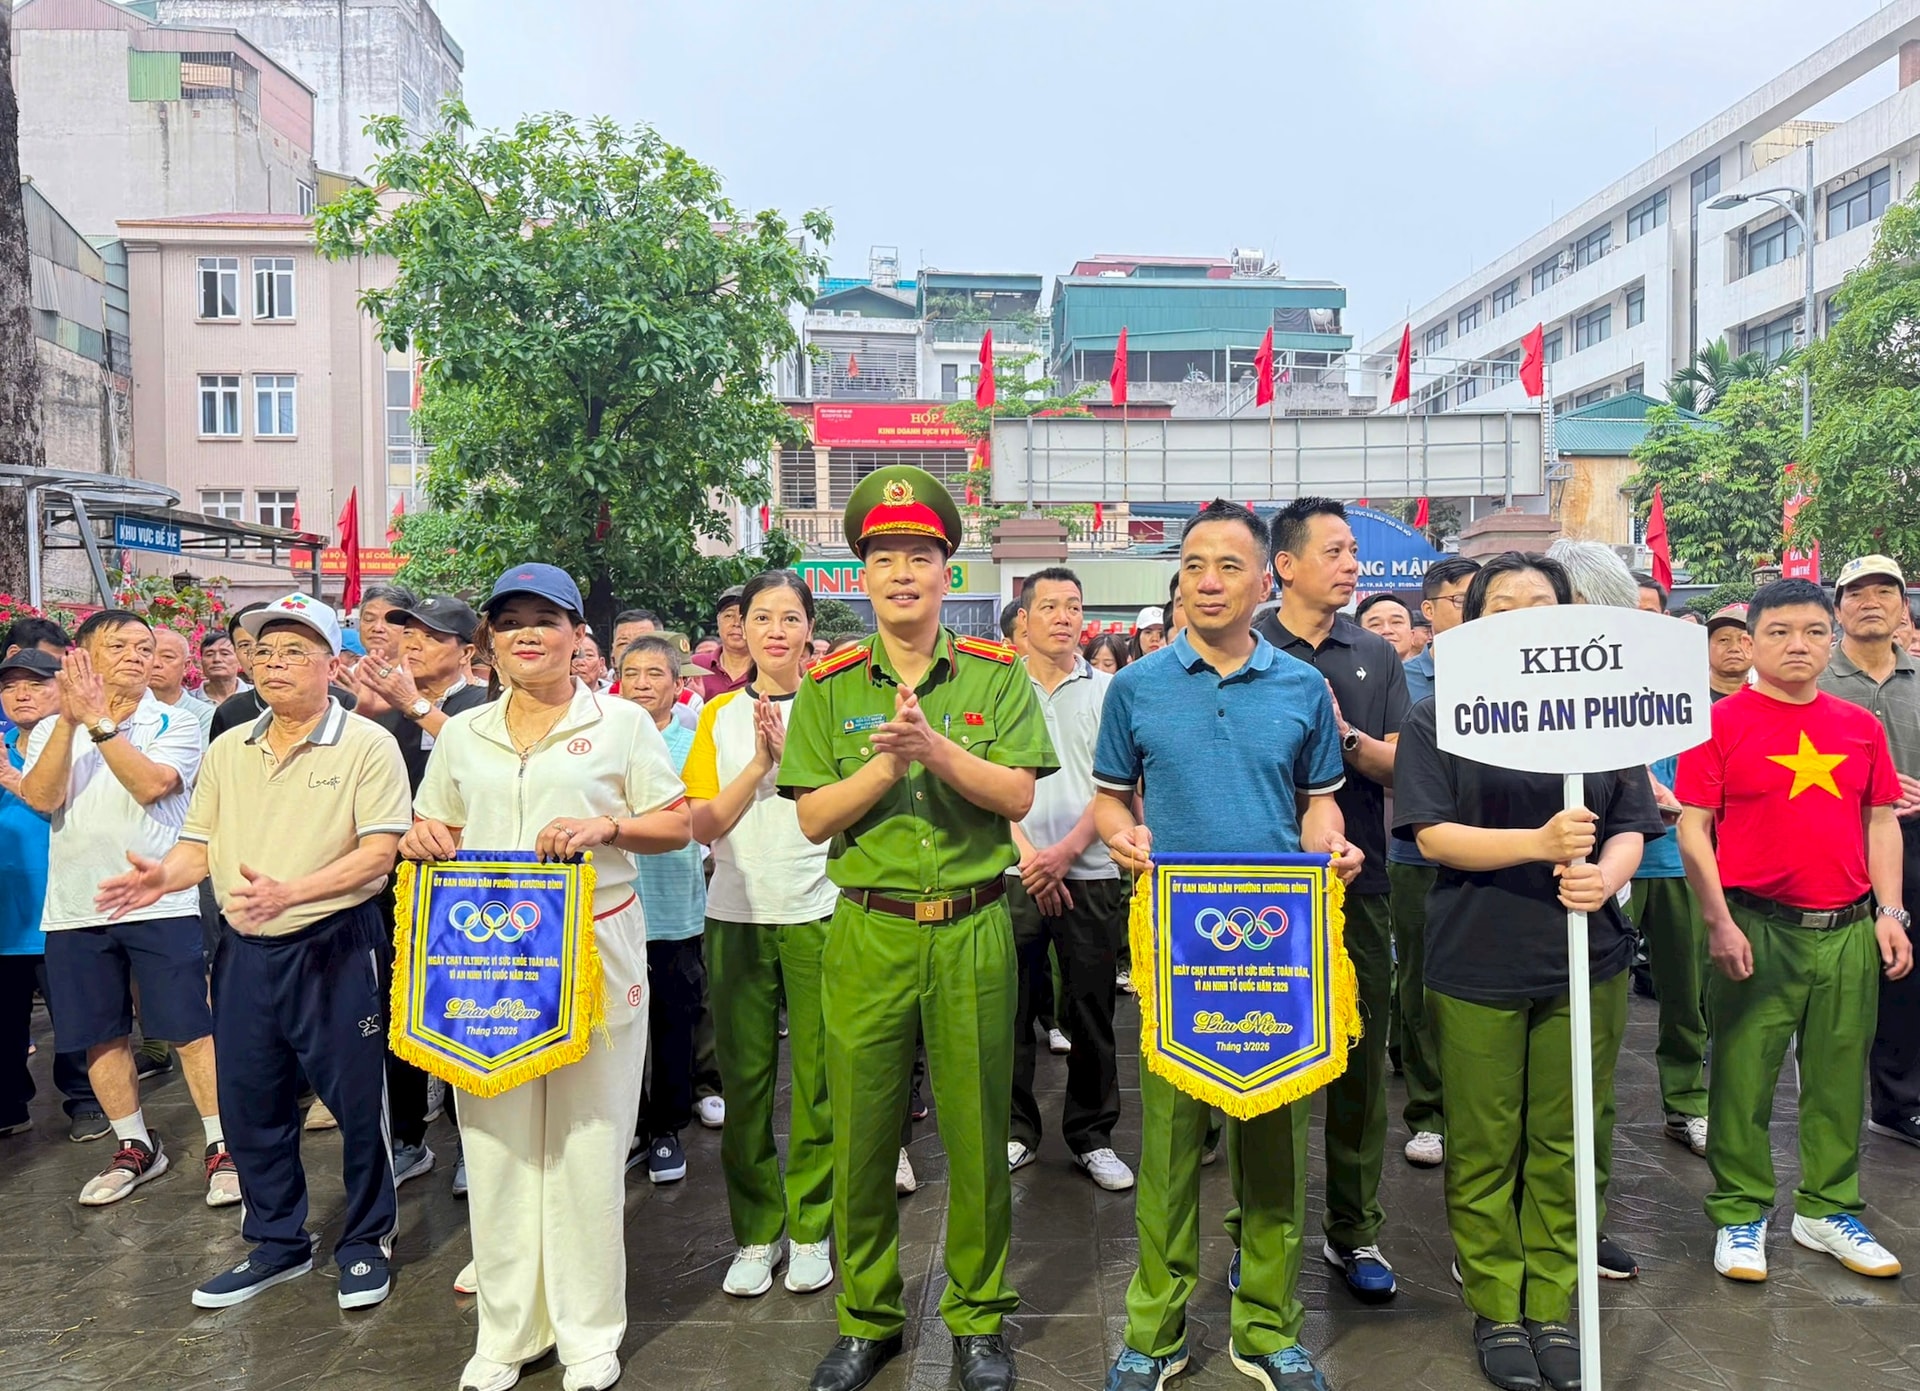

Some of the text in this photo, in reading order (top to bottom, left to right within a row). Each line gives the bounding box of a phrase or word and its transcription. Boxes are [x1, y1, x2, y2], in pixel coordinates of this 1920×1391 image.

[878, 427, 896, 435] KINH
[897, 427, 921, 435] DOANH
[922, 427, 939, 436] DỊCH
[940, 427, 950, 436] VỤ
[119, 524, 177, 548] KHU VỰC ĐỂ XE
[1520, 634, 1624, 674] KHỐI
[1454, 686, 1693, 736] CÔNG AN PHƯỜNG
[442, 877, 458, 887] BAN
[458, 876, 478, 888] NHÂN
[478, 876, 492, 888] DÂN
[493, 877, 519, 889] PHƯỜNG
[1182, 883, 1197, 893] BAN
[1198, 881, 1217, 893] NHÂN
[1218, 881, 1233, 893] DÂN
[1234, 881, 1262, 894] PHƯỜNG
[427, 953, 445, 965] NGÀY
[446, 955, 462, 967] CHẠY
[463, 955, 490, 966] OLYMPIC
[491, 954, 498, 966] VÌ
[498, 954, 511, 966] SỨC
[528, 955, 545, 967] TOÀN
[456, 970, 466, 980] AN
[466, 970, 482, 980] NINH
[483, 966, 491, 980] TỔ
[491, 967, 509, 981] QUỐC
[509, 968, 524, 980] NĂM
[524, 971, 539, 981] 2026
[1172, 963, 1190, 976] NGÀY
[1190, 965, 1207, 978] CHẠY
[1208, 965, 1236, 976] OLYMPIC
[1237, 963, 1244, 976] VÌ
[1244, 963, 1258, 976] SỨC
[1276, 964, 1294, 977] TOÀN
[1202, 980, 1212, 991] AN
[1212, 980, 1229, 991] NINH
[1229, 977, 1238, 992] TỔ
[1238, 977, 1256, 992] QUỐC
[1256, 979, 1272, 992] NĂM
[1272, 981, 1289, 992] 2026
[443, 997, 541, 1022] Lưu Niệm
[1192, 1010, 1293, 1036] Lưu Niệm
[466, 1025, 518, 1037] Tháng 3/2026
[1216, 1041, 1270, 1053] Tháng 3/2026
